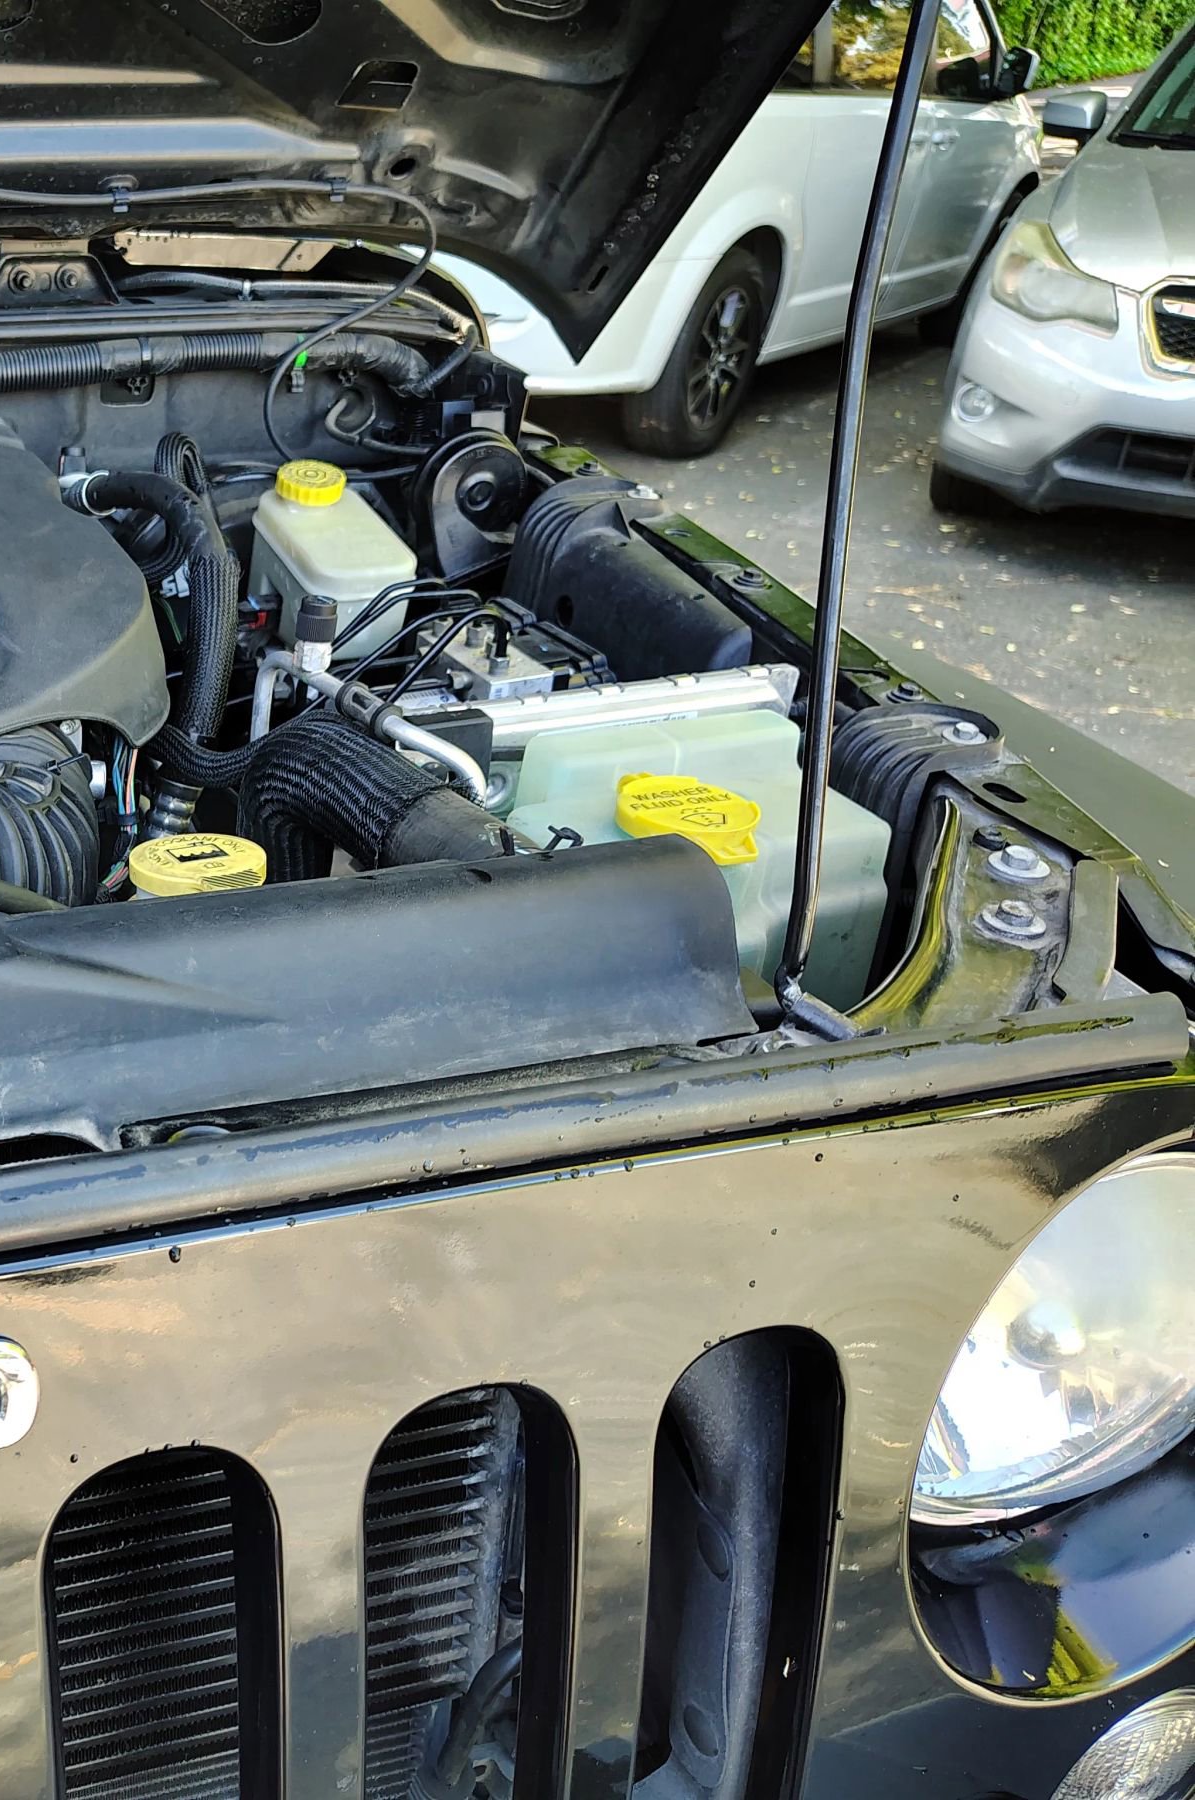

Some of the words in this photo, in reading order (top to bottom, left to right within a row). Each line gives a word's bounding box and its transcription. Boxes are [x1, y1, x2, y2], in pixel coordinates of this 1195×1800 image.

[629, 799, 684, 811] FLUID
[686, 792, 733, 805] ONLY
[631, 786, 712, 802] WASHER
[154, 835, 219, 847] COOLANT
